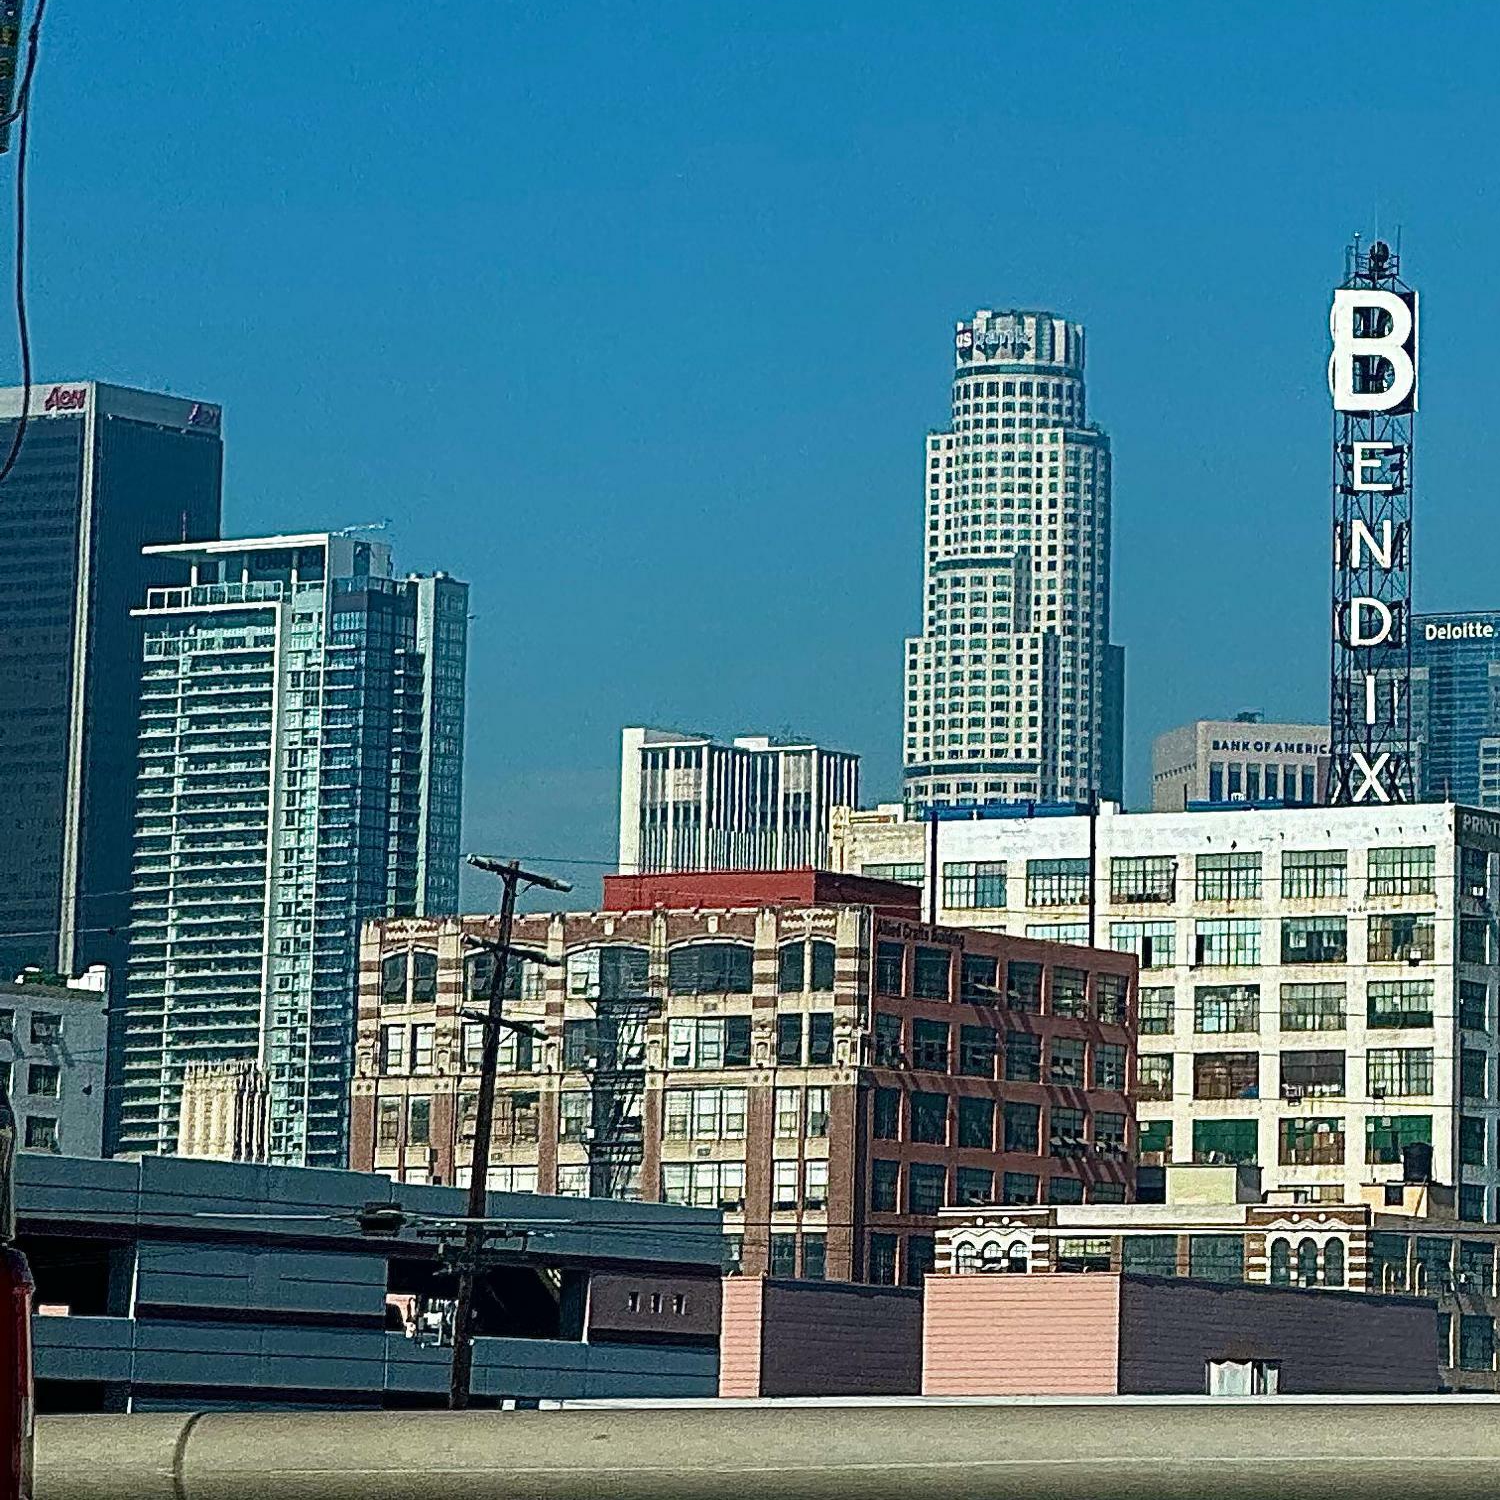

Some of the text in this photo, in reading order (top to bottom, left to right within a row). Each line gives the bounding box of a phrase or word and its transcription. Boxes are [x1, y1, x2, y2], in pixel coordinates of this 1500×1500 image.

[1333, 289, 1415, 803] BENDIX
[1212, 740, 1249, 751] BANK
[1254, 741, 1270, 752] OF
